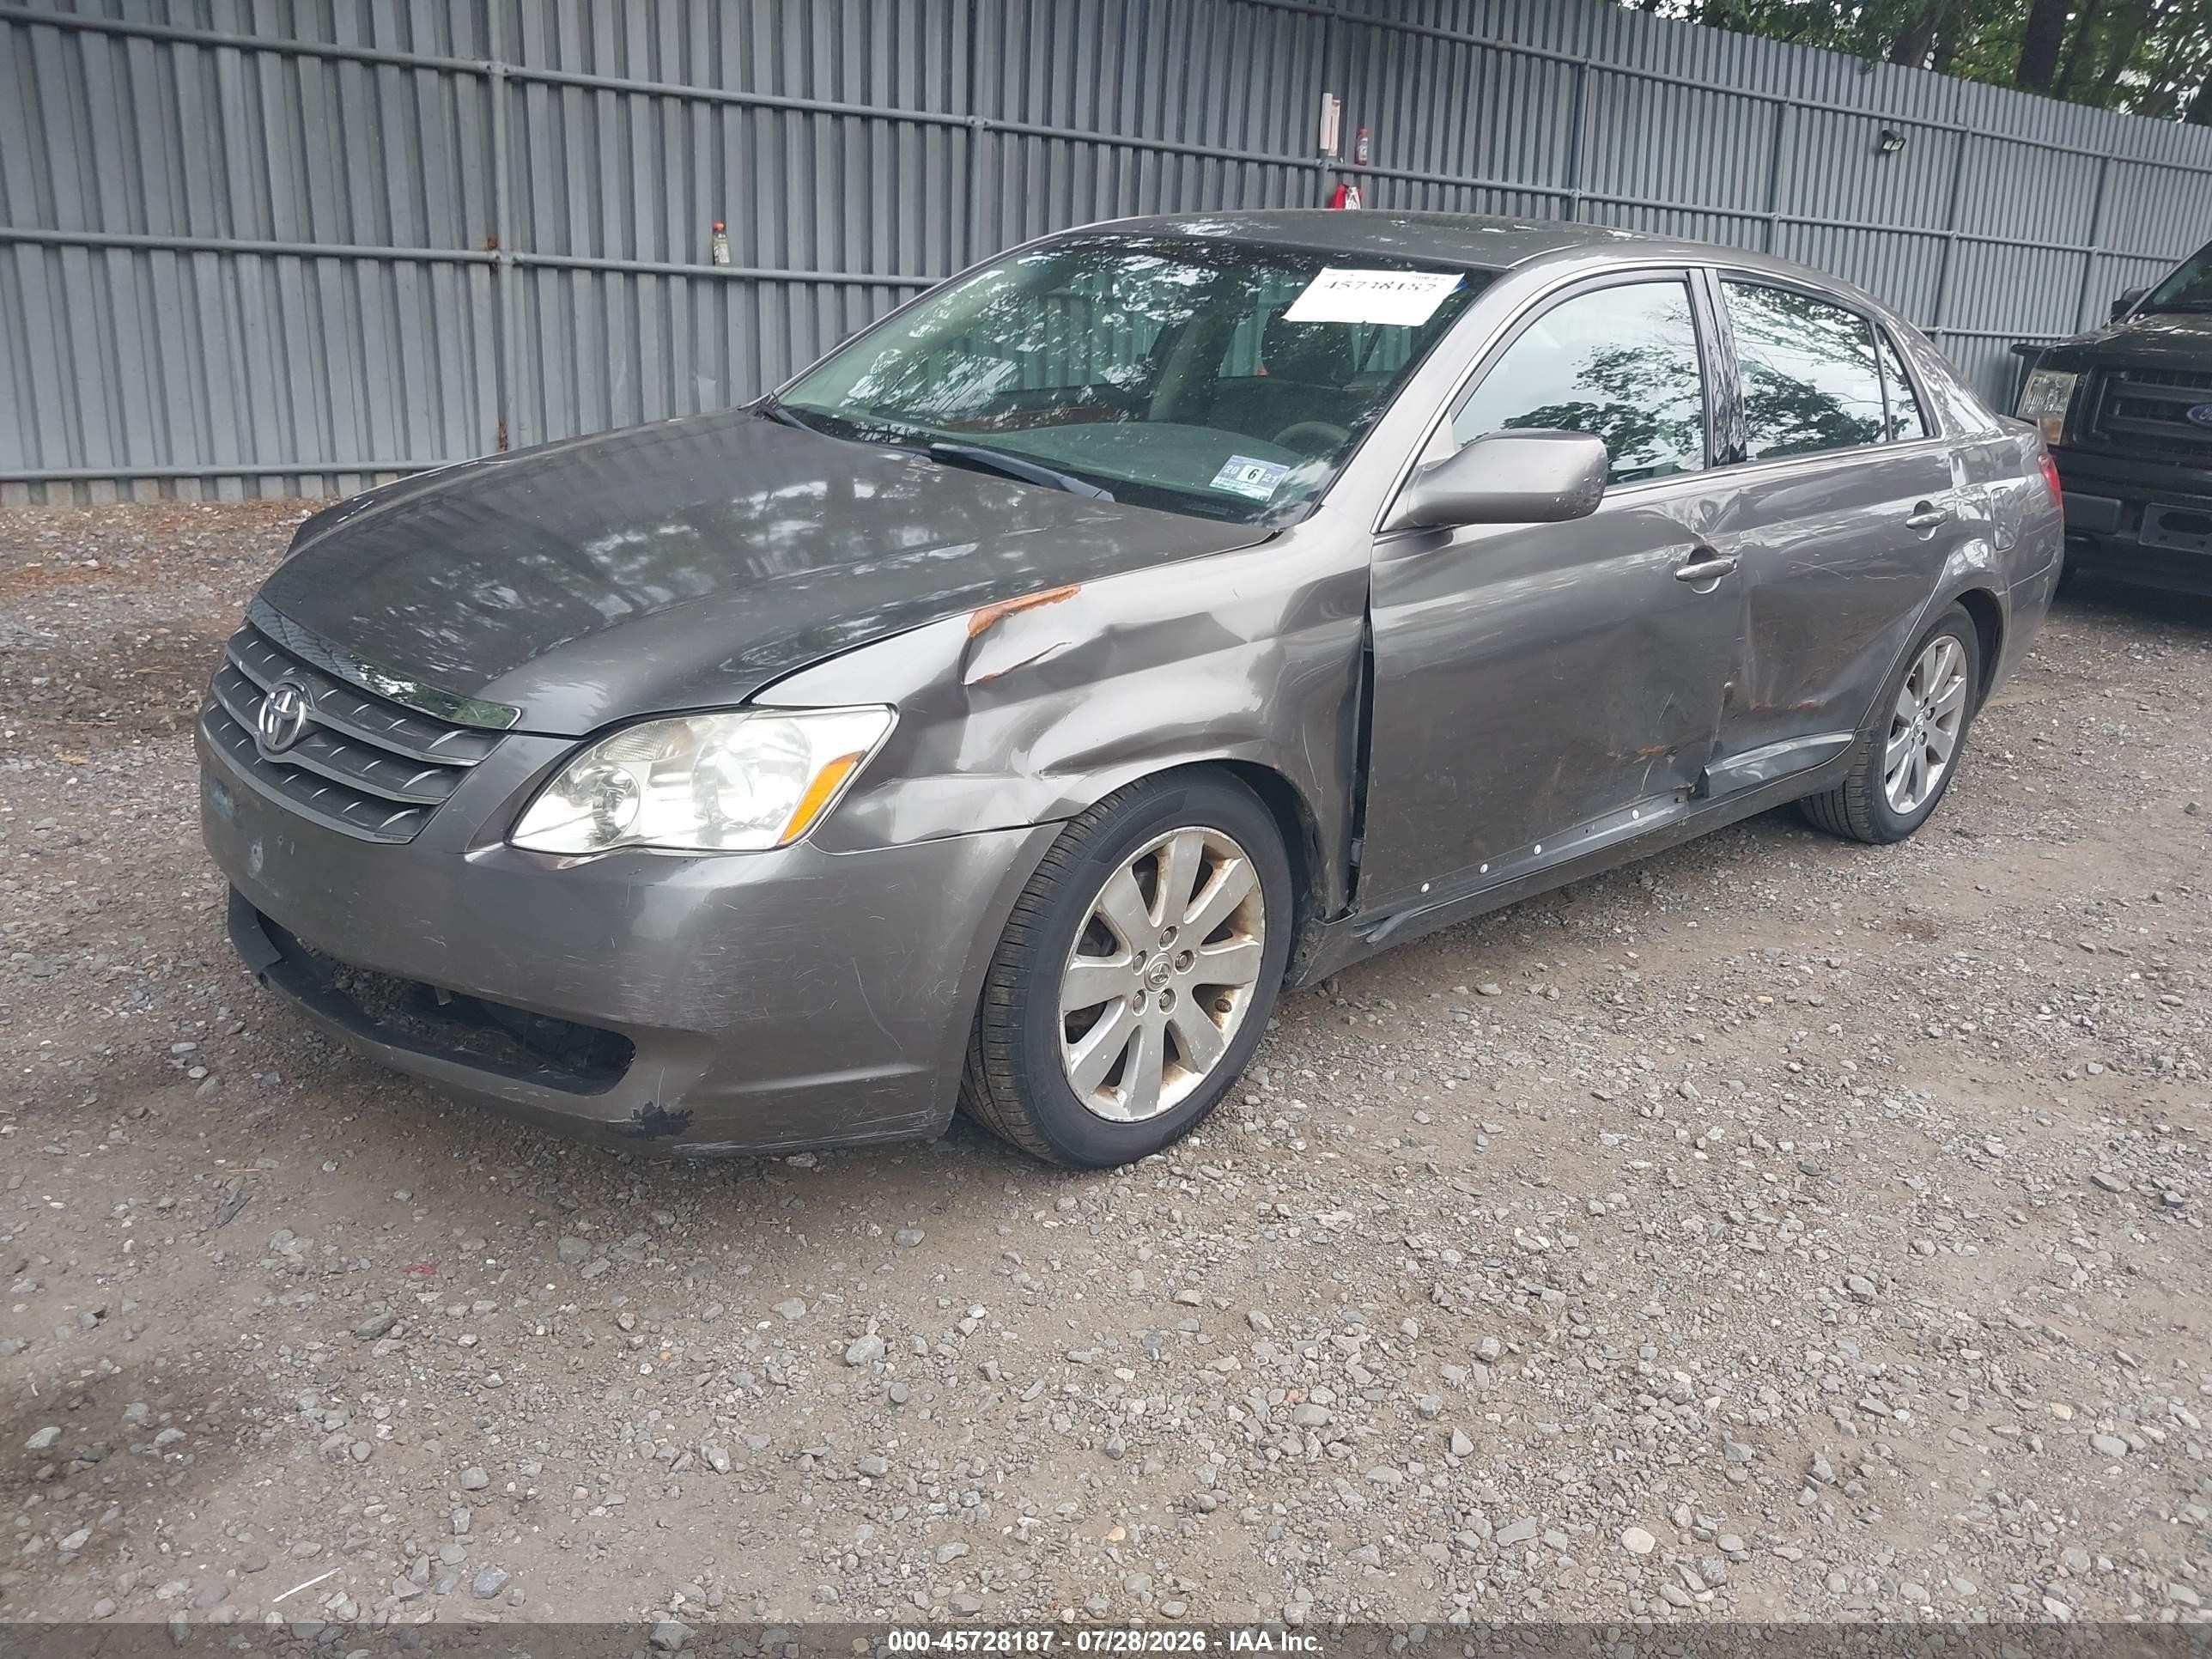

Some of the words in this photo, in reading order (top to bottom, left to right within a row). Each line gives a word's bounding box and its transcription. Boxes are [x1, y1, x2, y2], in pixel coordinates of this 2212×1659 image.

[1223, 465, 1241, 475] 20
[1248, 468, 1260, 480] 6
[1261, 473, 1279, 483] 21
